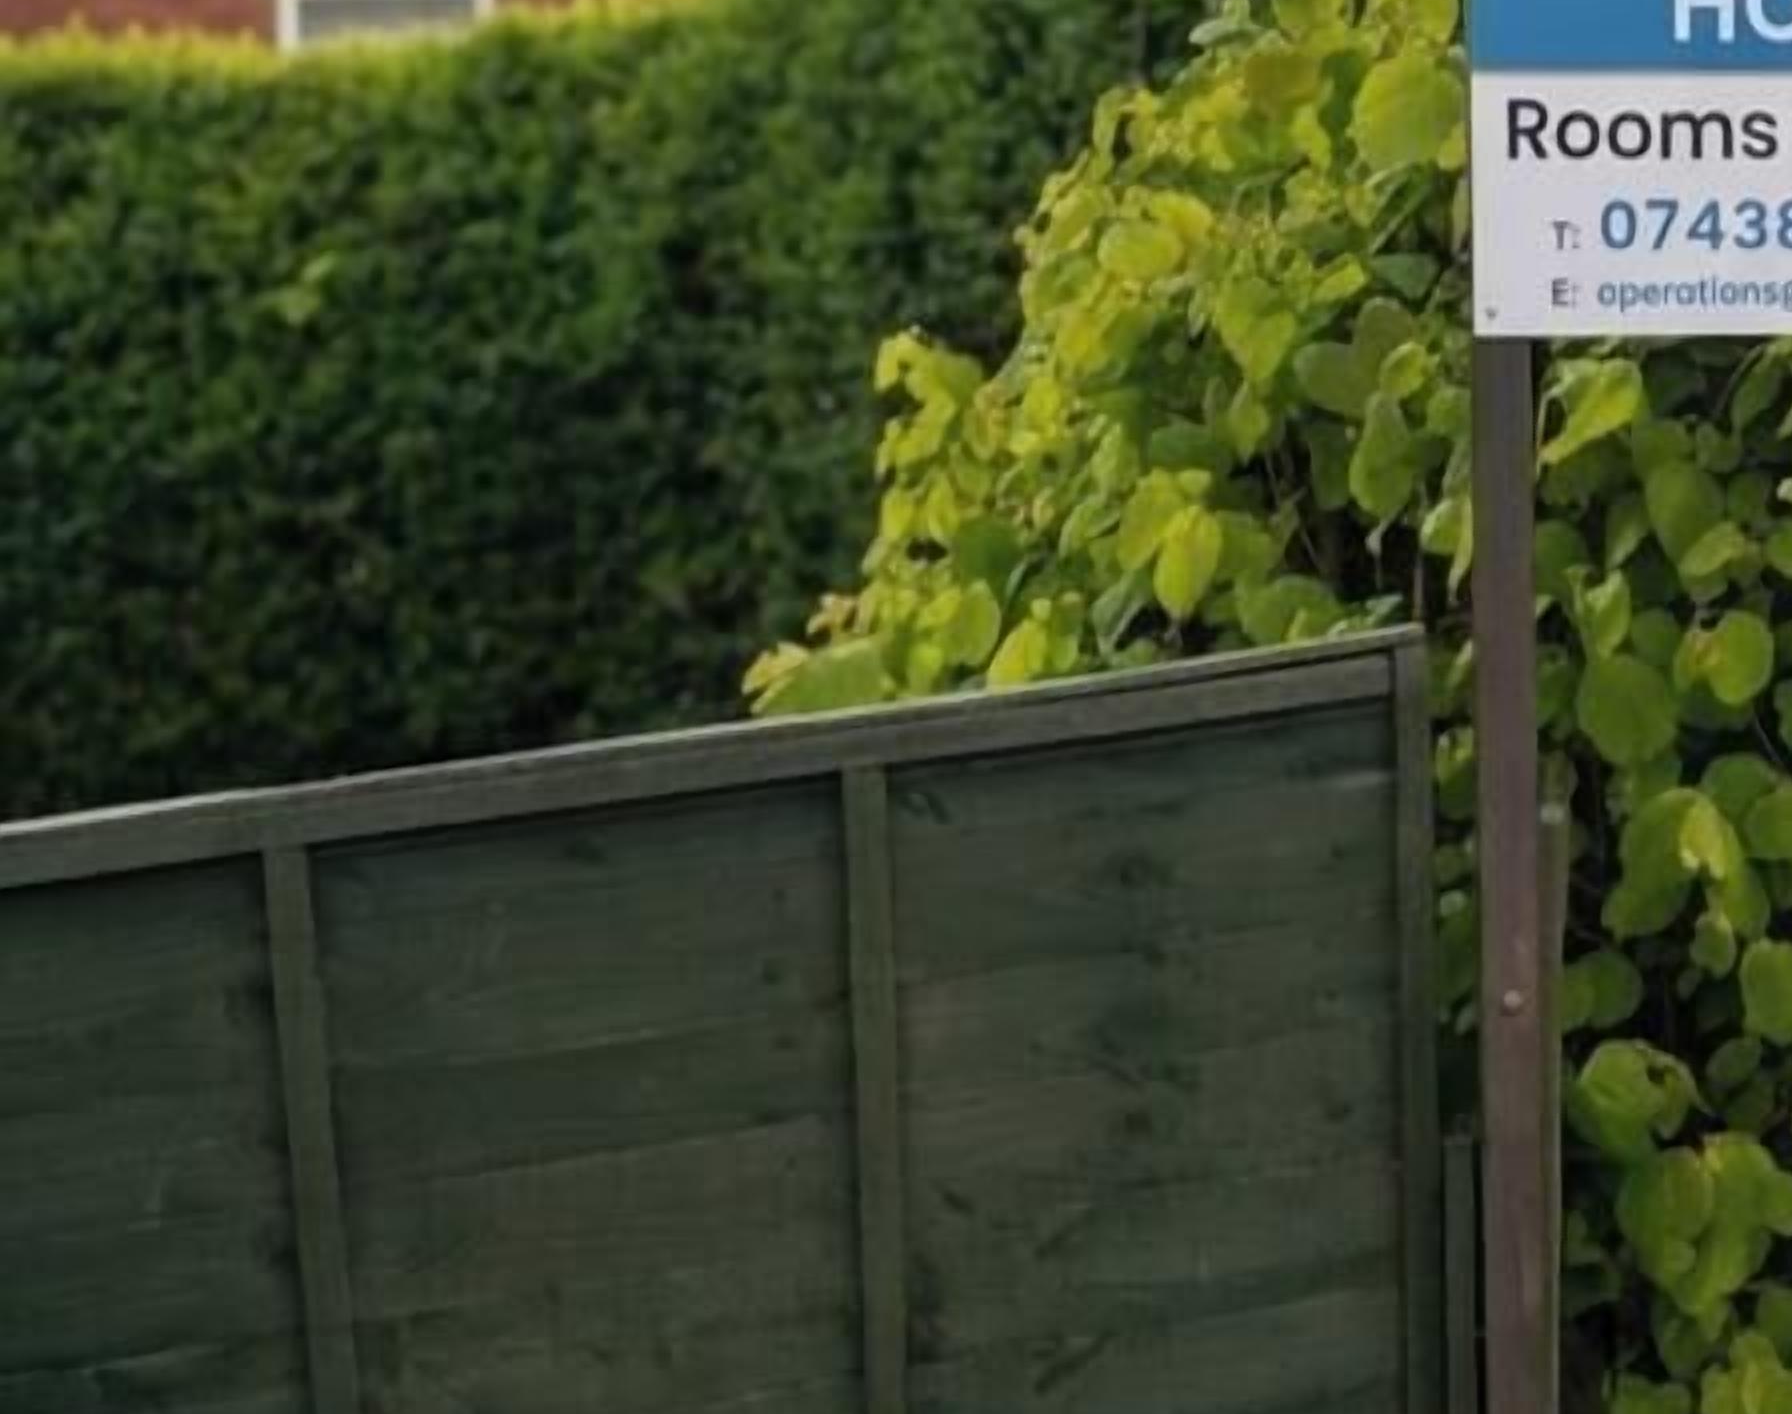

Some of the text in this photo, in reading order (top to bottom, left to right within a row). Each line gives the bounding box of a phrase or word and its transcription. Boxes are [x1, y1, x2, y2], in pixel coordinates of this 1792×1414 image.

[1506, 97, 1779, 161] Rooms
[1551, 219, 1581, 252] T:
[1551, 276, 1578, 307] E:
